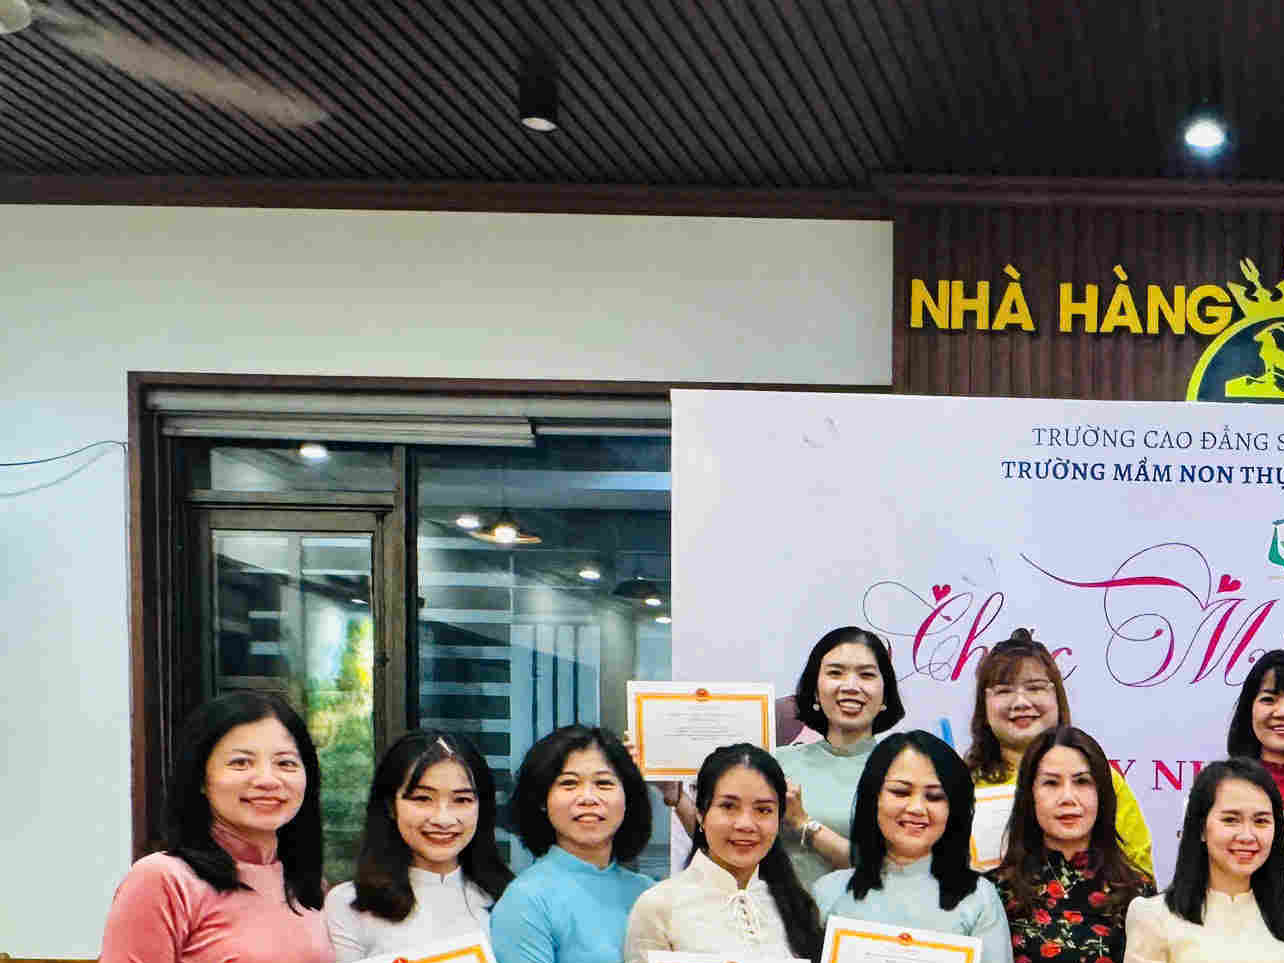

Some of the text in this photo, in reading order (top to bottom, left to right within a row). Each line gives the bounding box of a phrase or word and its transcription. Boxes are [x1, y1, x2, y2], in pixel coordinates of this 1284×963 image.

[910, 264, 1035, 330] NHÀ
[1059, 264, 1233, 335] HÀNG
[1032, 425, 1136, 449] TRƯỜNG
[1143, 430, 1193, 449] CAO
[1200, 424, 1270, 452] ĐẲNG
[1000, 457, 1105, 481] TRƯỜNG
[1179, 464, 1234, 484] NON
